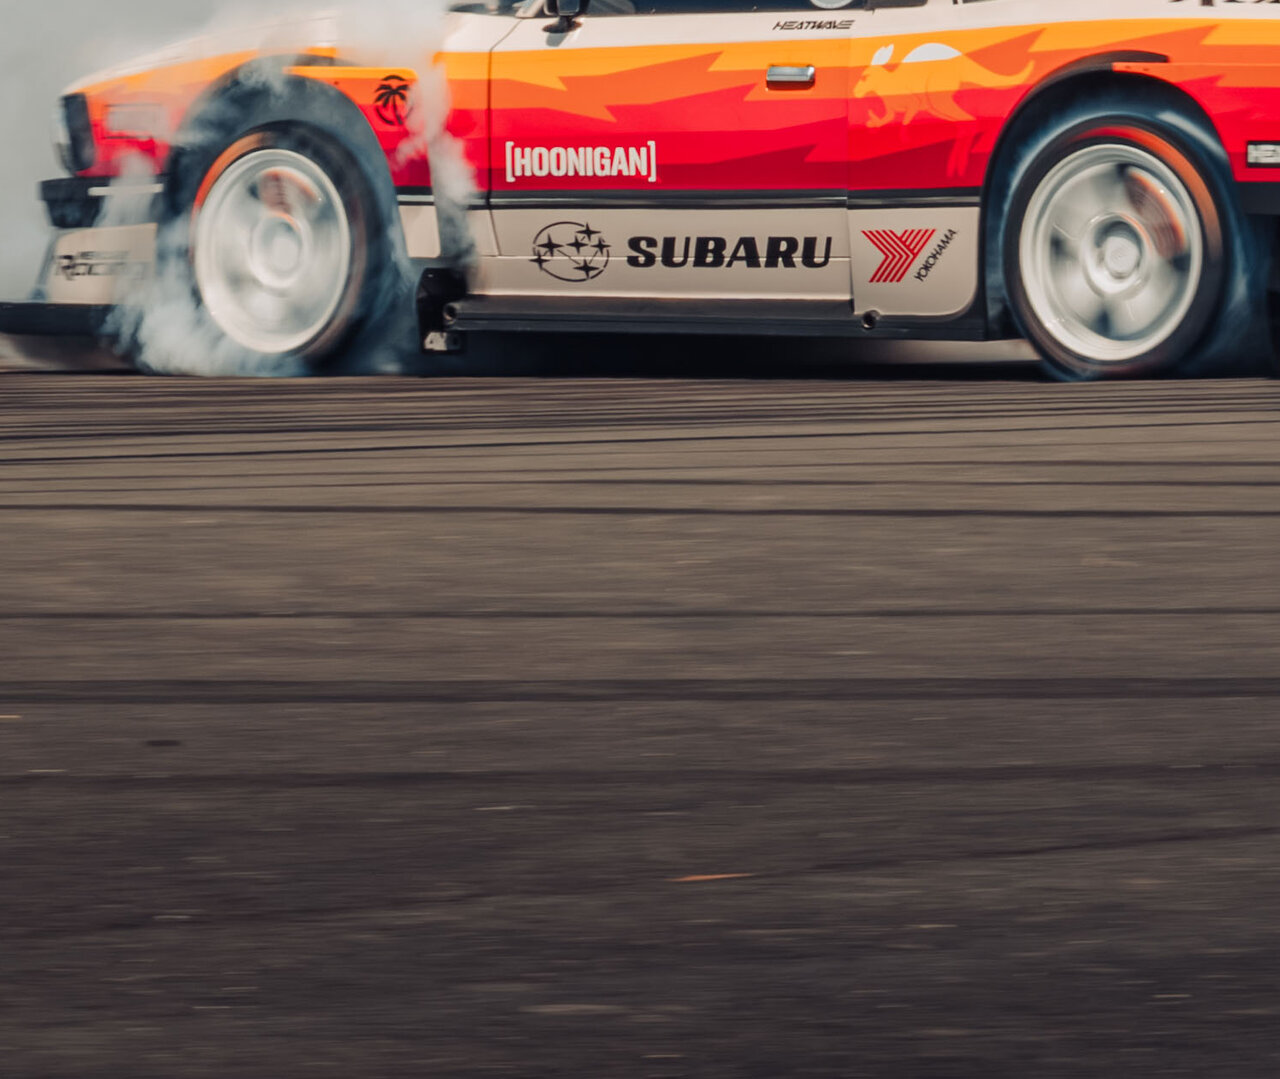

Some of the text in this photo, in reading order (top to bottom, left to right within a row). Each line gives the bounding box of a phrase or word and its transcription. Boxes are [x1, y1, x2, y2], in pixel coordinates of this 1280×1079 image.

[772, 20, 855, 30] HEATWAVE
[626, 236, 832, 268] SUBARU
[914, 229, 957, 282] YOKOHAMA
